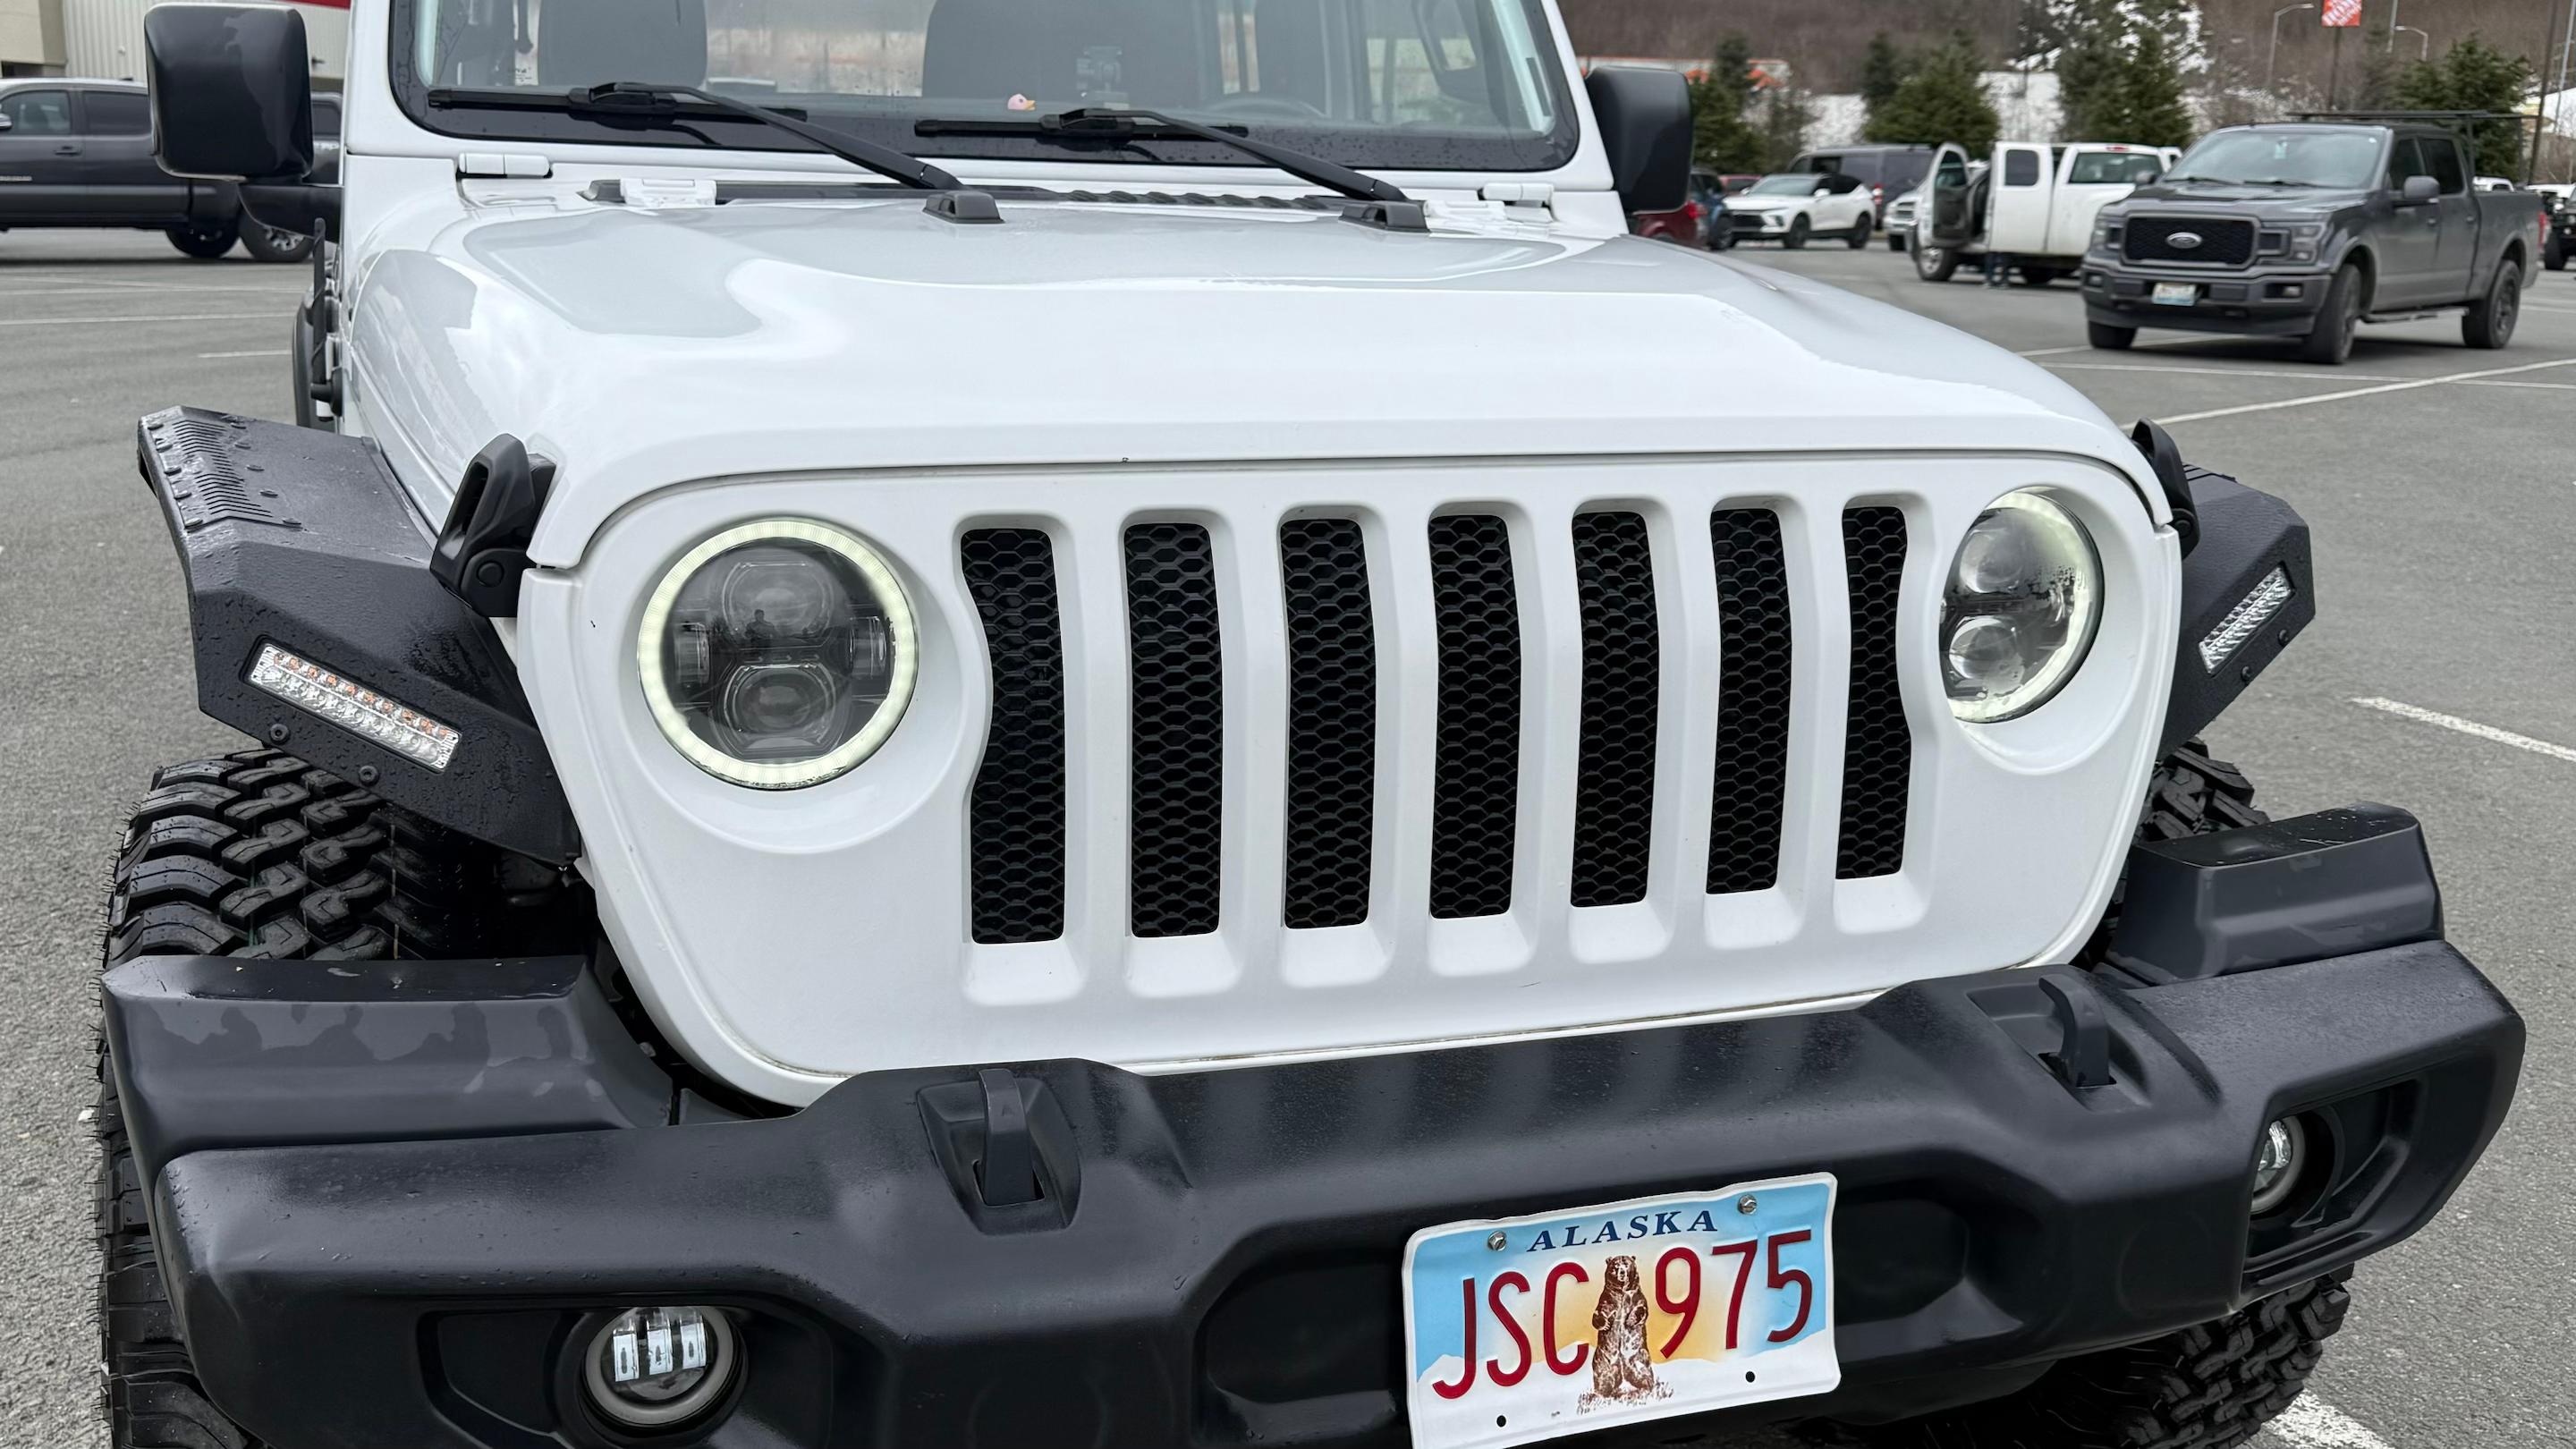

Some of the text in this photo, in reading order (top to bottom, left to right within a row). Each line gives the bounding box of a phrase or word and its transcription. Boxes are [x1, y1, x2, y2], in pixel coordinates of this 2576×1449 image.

[1527, 1210, 1718, 1251] ALASKA
[1432, 1229, 1813, 1400] JSC 975
